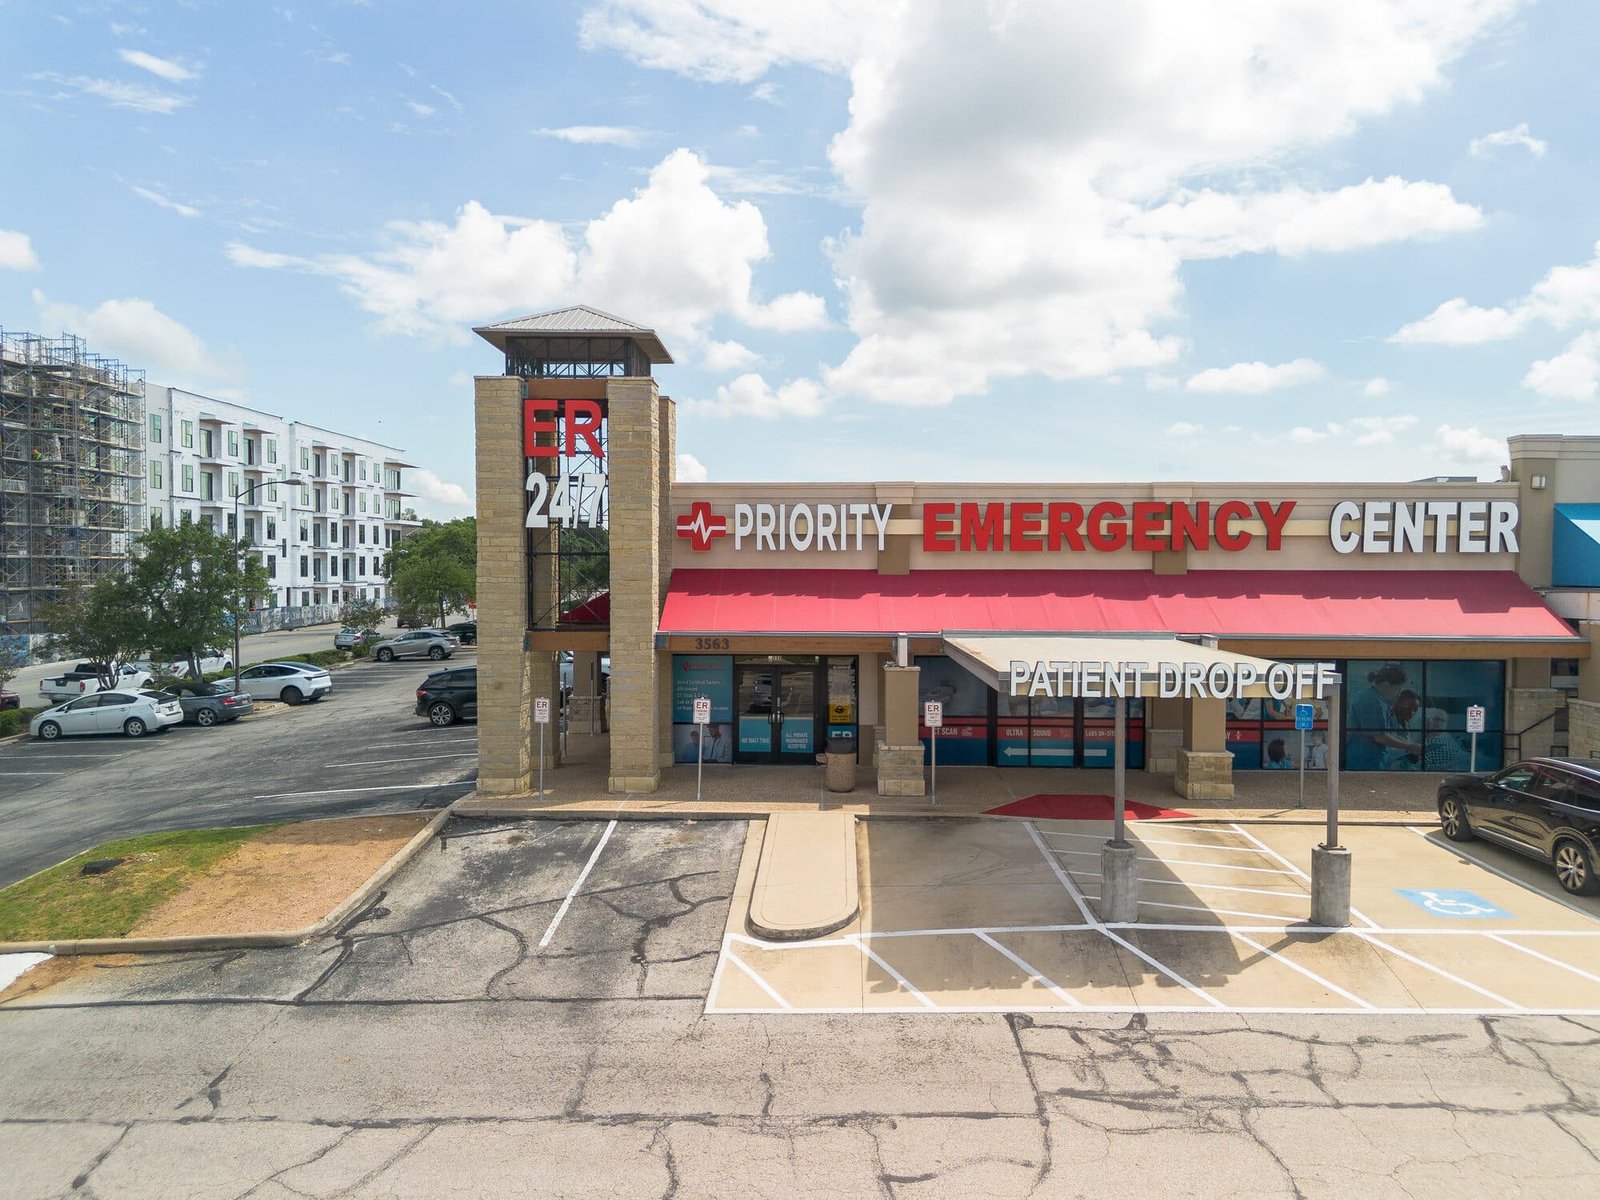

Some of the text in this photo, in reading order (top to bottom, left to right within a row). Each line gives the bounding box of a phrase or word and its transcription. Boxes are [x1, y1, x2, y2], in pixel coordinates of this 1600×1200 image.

[523, 399, 606, 457] ER
[525, 472, 608, 528] 24/7
[734, 500, 1520, 553] PRIORITY EMERGENCY CENTER
[695, 638, 730, 650] 3563
[1010, 660, 1336, 700] PATIENT DROP OFF
[942, 727, 958, 735] SCAN
[1005, 729, 1052, 737] ULTRA SOUND
